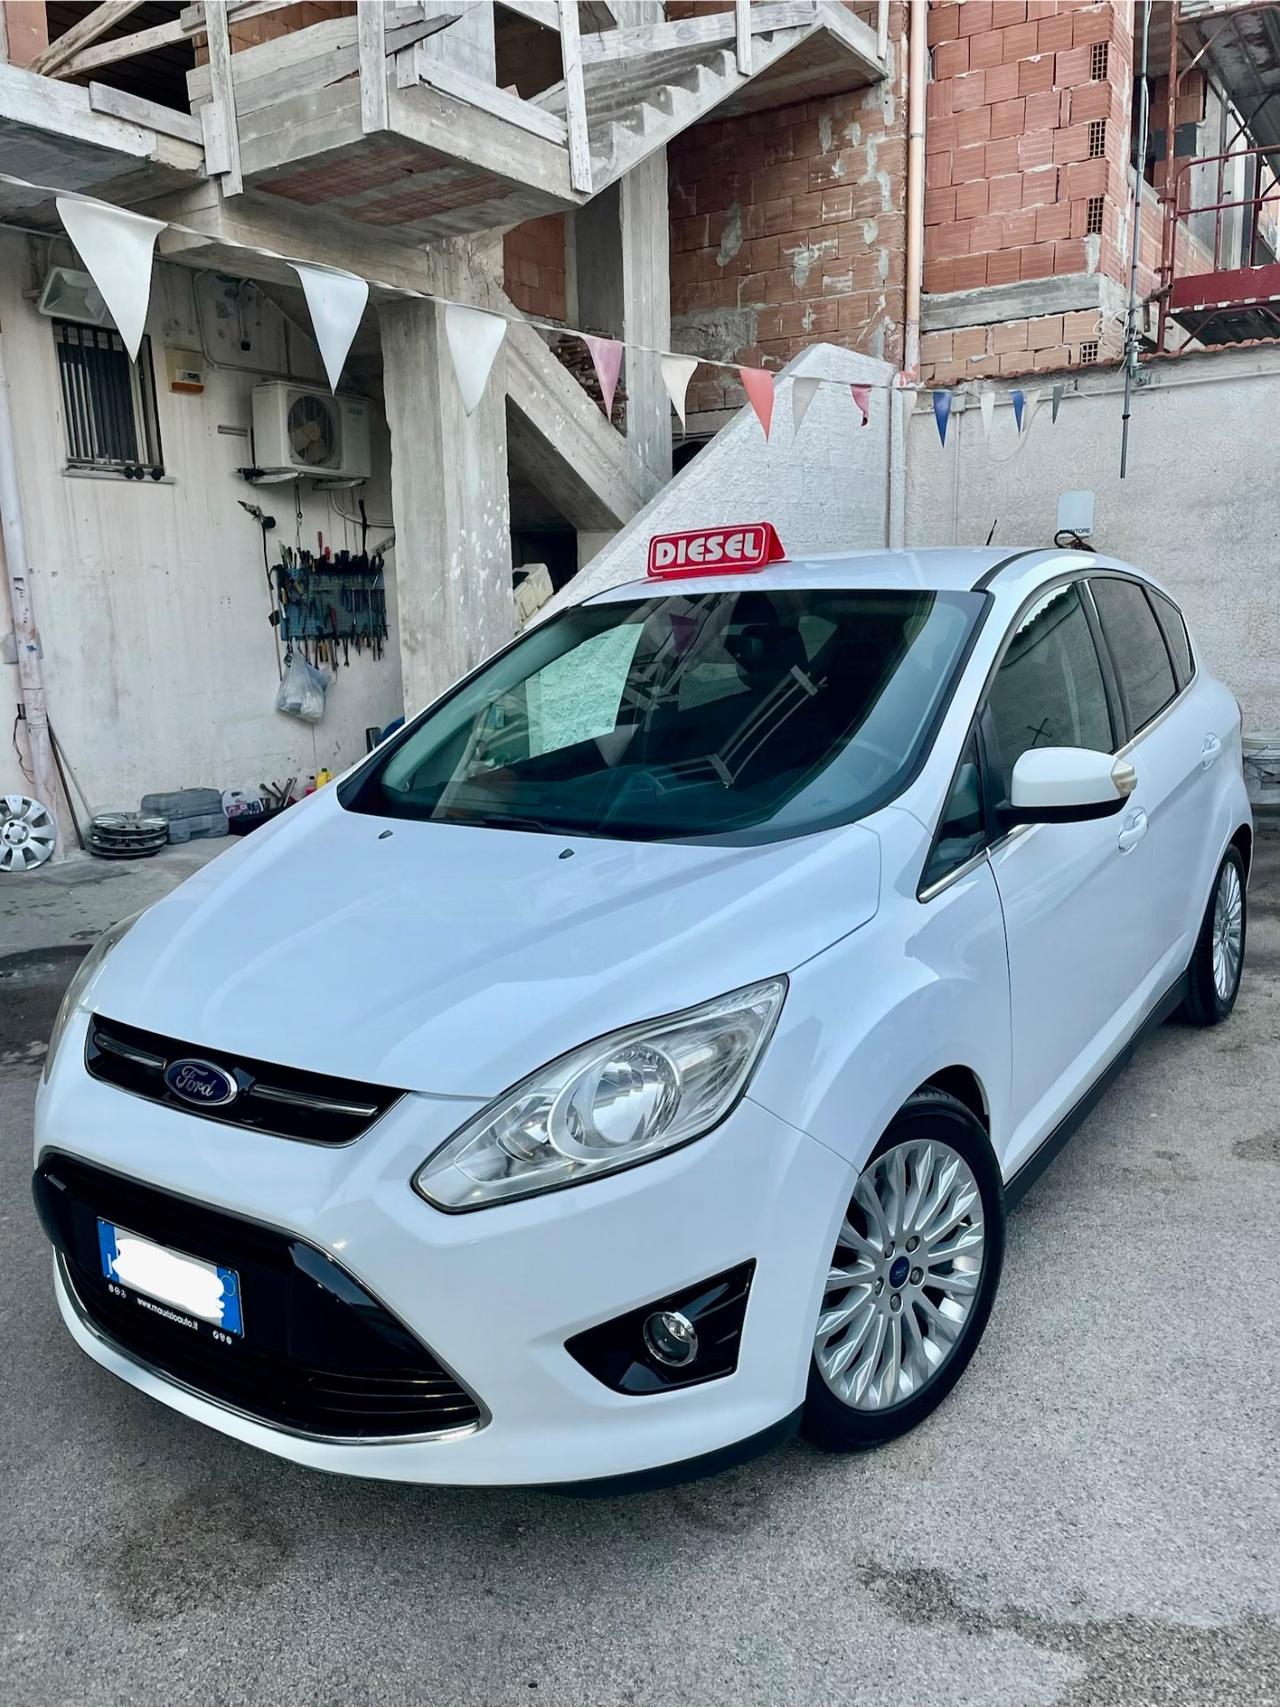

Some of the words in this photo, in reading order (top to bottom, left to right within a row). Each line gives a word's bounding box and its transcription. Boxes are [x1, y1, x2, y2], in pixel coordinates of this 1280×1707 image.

[655, 532, 760, 567] DIESEL
[175, 1065, 217, 1097] Ford
[136, 1297, 199, 1331] www.maurizioauto.it
